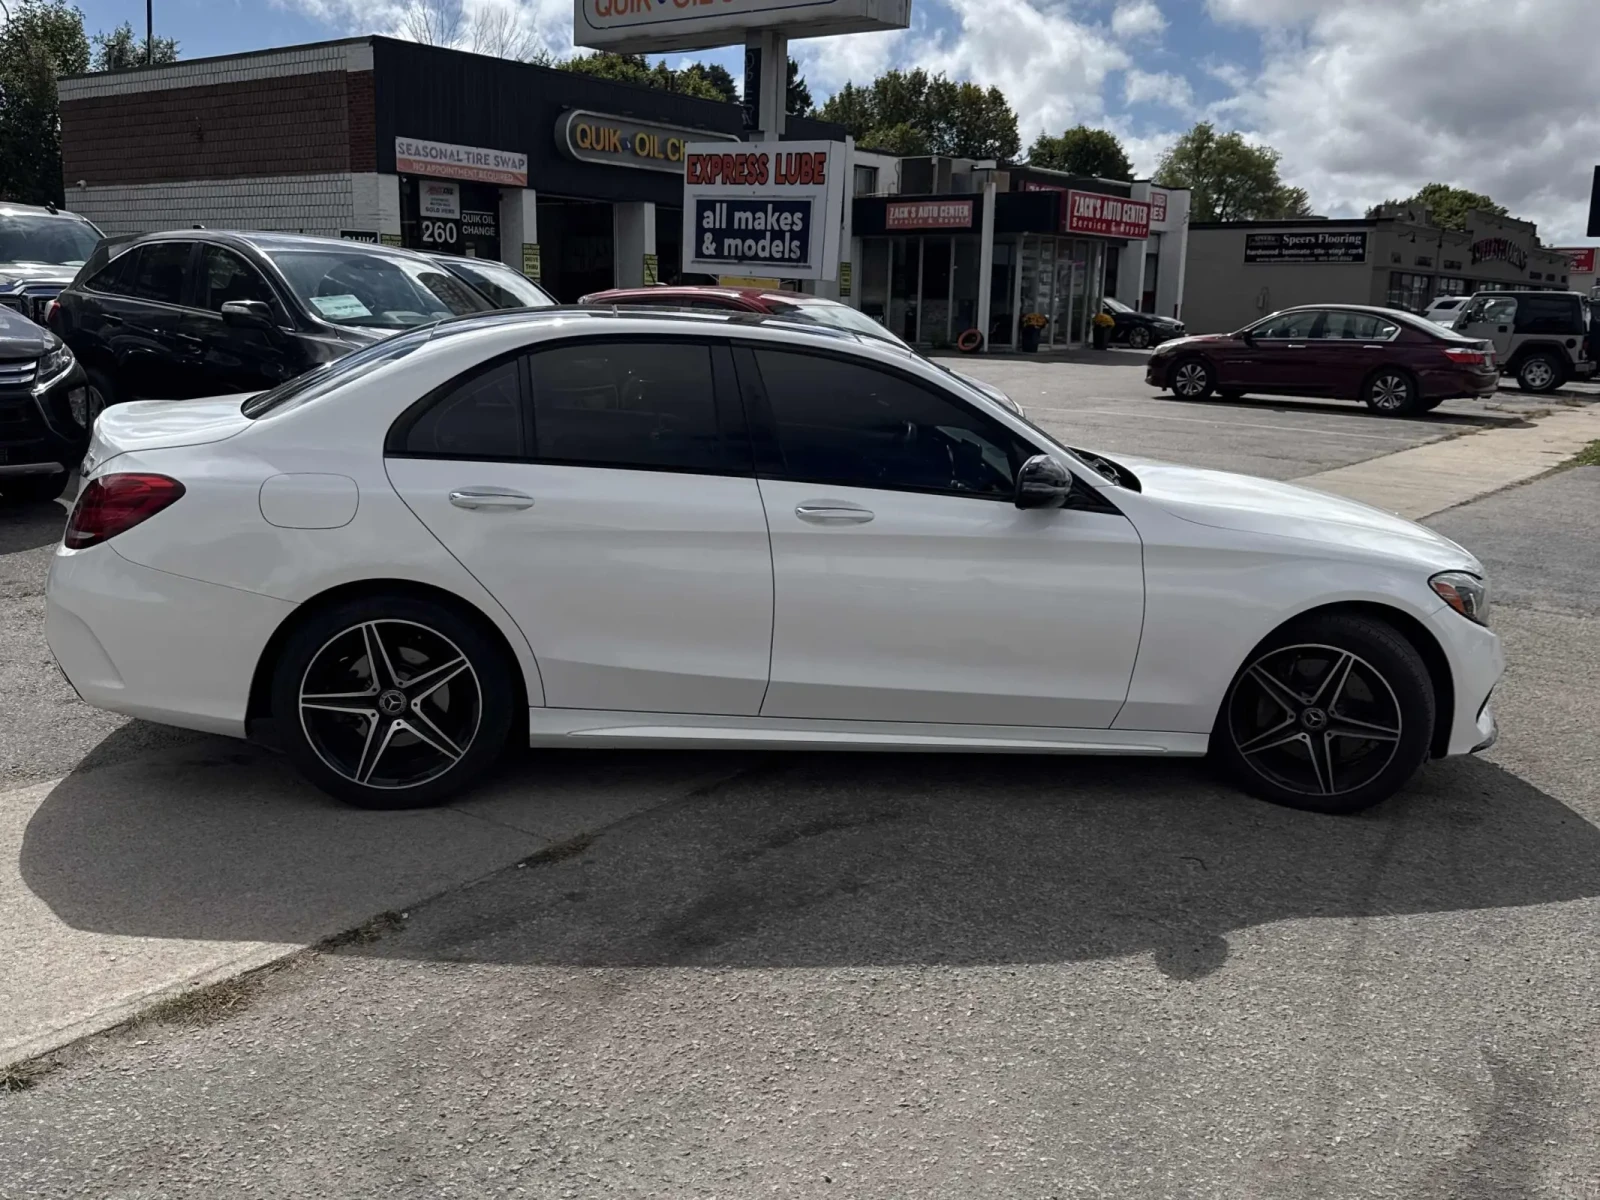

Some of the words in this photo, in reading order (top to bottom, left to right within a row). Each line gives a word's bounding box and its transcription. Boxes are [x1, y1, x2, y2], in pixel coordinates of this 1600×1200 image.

[576, 123, 622, 153] QUIK
[635, 132, 664, 159] OIL
[398, 142, 463, 162] SEASONAL
[464, 151, 490, 166] TIRE
[494, 155, 525, 170] SWAP
[686, 153, 769, 185] EXPRESS
[774, 152, 827, 185] LUBE
[412, 162, 424, 171] NO
[427, 164, 477, 178] APPOINTMENT
[461, 214, 481, 224] QUIK
[482, 215, 496, 225] OIL
[702, 203, 727, 229] all
[733, 203, 803, 231] makes
[889, 206, 917, 219] ZACK'S
[918, 206, 939, 218] AUTO
[939, 205, 969, 217] CENTER
[1073, 196, 1101, 218] ZACK'S
[1102, 200, 1122, 221] AUTO
[1122, 203, 1148, 225] CENTER
[421, 220, 457, 244] 260
[462, 225, 496, 236] CHANGE
[1282, 234, 1316, 247] Speers
[1318, 233, 1362, 246] Flooring
[702, 232, 717, 255] &
[723, 231, 801, 259] models
